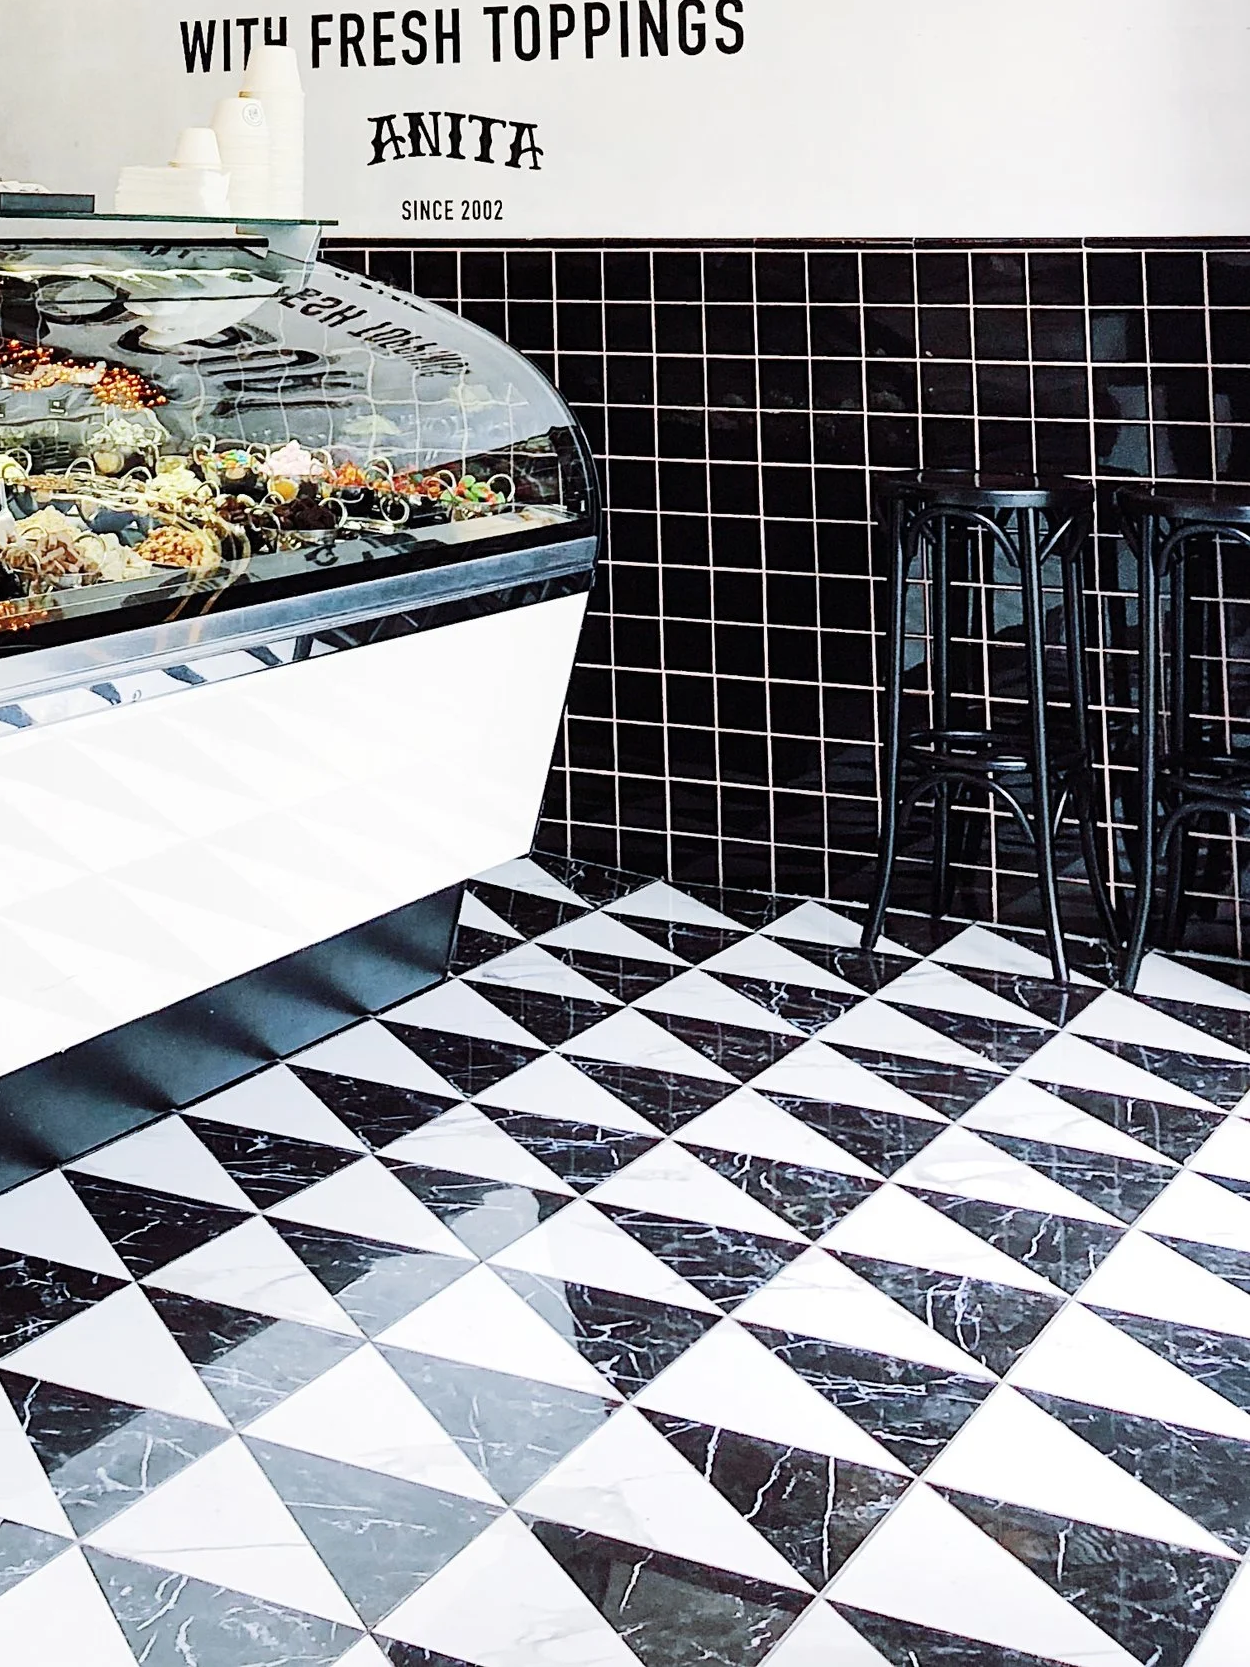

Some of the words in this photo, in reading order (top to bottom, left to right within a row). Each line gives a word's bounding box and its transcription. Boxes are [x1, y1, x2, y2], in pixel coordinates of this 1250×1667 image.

[179, 16, 288, 74] WITH
[311, 8, 461, 69] FRESH
[366, 111, 544, 171] ANITA
[401, 199, 454, 221] SINCE
[461, 199, 503, 221] 2002
